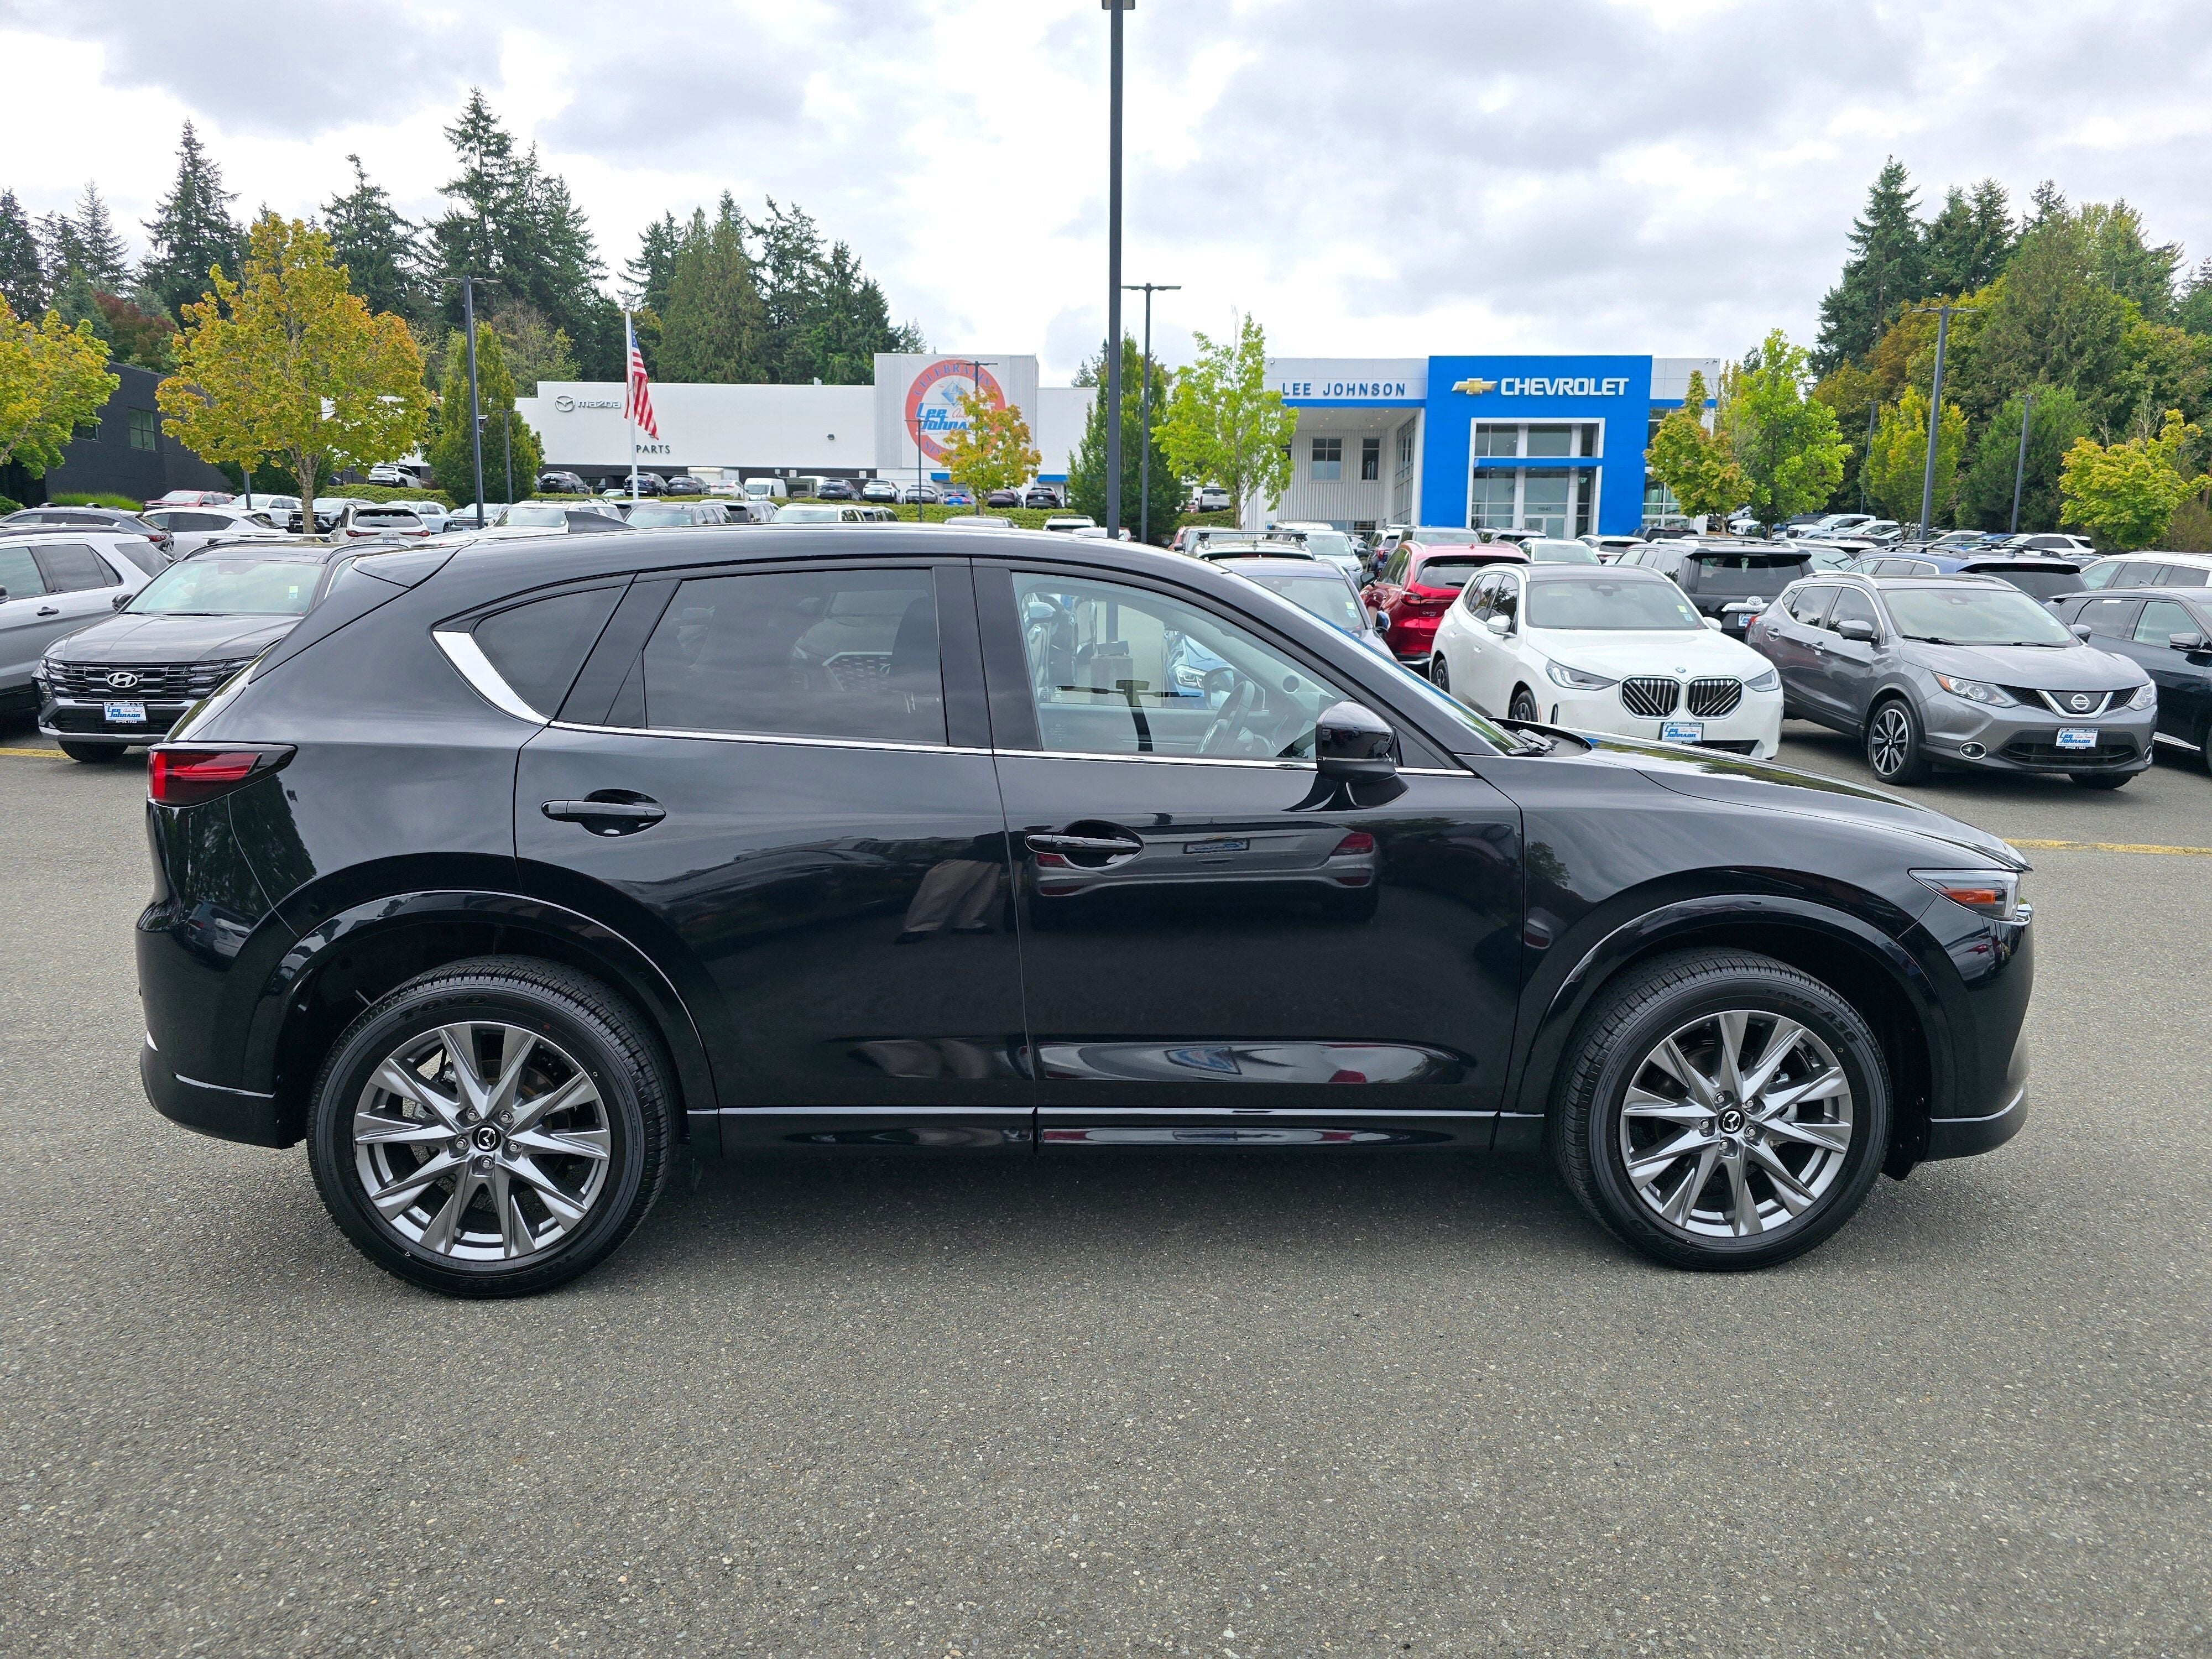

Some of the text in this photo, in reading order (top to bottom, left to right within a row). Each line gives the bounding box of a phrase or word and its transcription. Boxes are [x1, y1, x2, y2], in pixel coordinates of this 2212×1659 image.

[1282, 382, 1406, 397] LEE JOHNSON
[1500, 378, 1629, 396] CHEVROLET
[578, 399, 621, 409] mazda
[916, 402, 948, 418] Lee
[637, 445, 671, 454] PARTS
[400, 994, 489, 1019] TOYO
